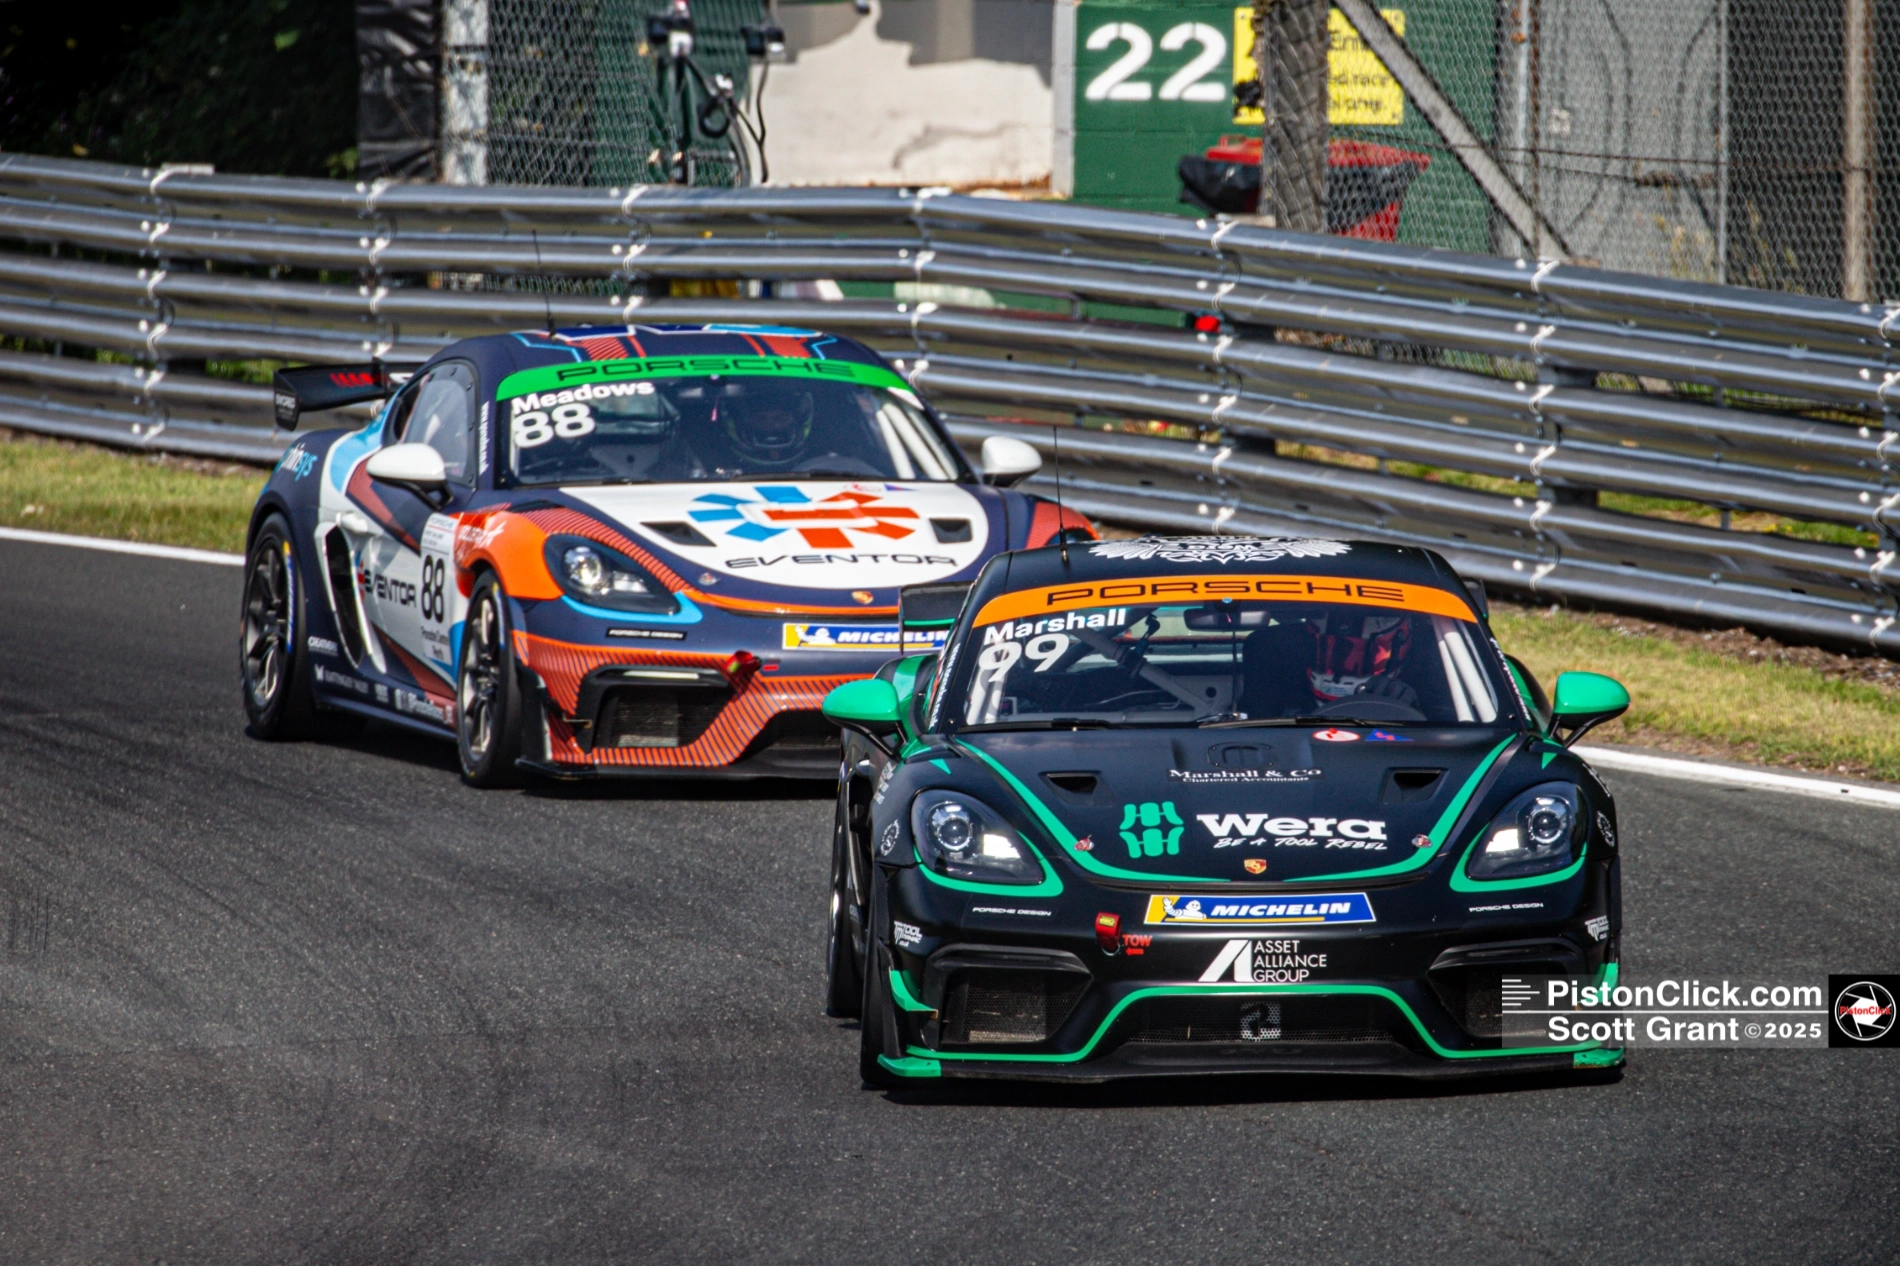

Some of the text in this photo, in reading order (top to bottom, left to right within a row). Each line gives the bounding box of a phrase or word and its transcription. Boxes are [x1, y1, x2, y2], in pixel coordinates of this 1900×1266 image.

[1085, 22, 1227, 101] 22
[556, 358, 856, 381] PORSCHE
[511, 382, 655, 415] Meadows
[513, 402, 596, 449] 88
[725, 553, 957, 569] EVENTOR
[364, 568, 418, 609] EVENTOR
[421, 553, 446, 625] 88
[1045, 580, 1405, 605] PORSCHE
[983, 608, 1127, 646] Marshall
[978, 632, 1069, 683] 99
[1169, 768, 1322, 778] Marshall & Co
[1196, 813, 1388, 841] Wera
[1213, 837, 1388, 851] BE A TOOL REBEL
[972, 906, 1052, 917] PORSCHE DESIGN
[1211, 903, 1351, 918] MICHELIN
[1469, 902, 1544, 913] PORSCHE DESIGN
[1122, 933, 1153, 947] TOW
[1254, 940, 1300, 953] ASSET
[1254, 954, 1327, 968] ALLIANCE
[1253, 969, 1310, 982] GROUP
